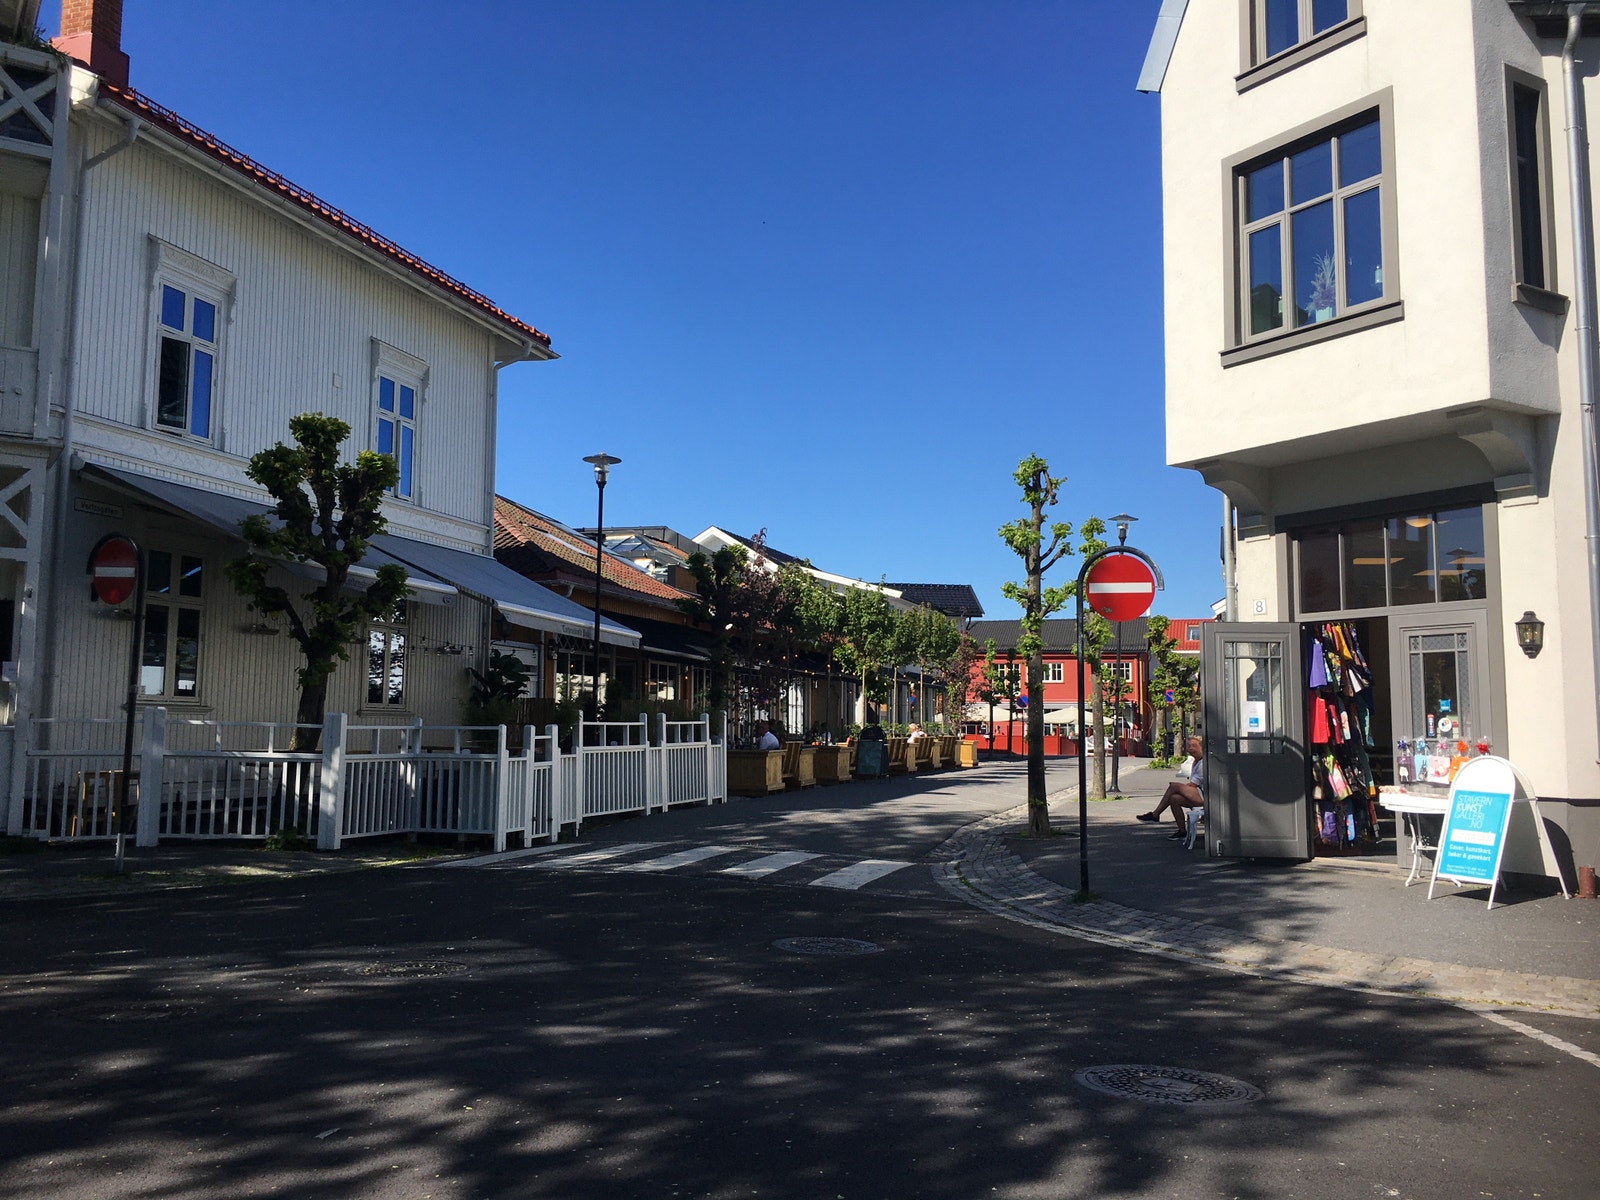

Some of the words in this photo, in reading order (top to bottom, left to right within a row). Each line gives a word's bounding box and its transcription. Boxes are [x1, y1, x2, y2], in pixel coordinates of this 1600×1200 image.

[1256, 601, 1263, 612] 8
[1458, 795, 1491, 805] STAVERN
[1456, 803, 1482, 811] KUNST
[1455, 811, 1485, 820] GALLERI
